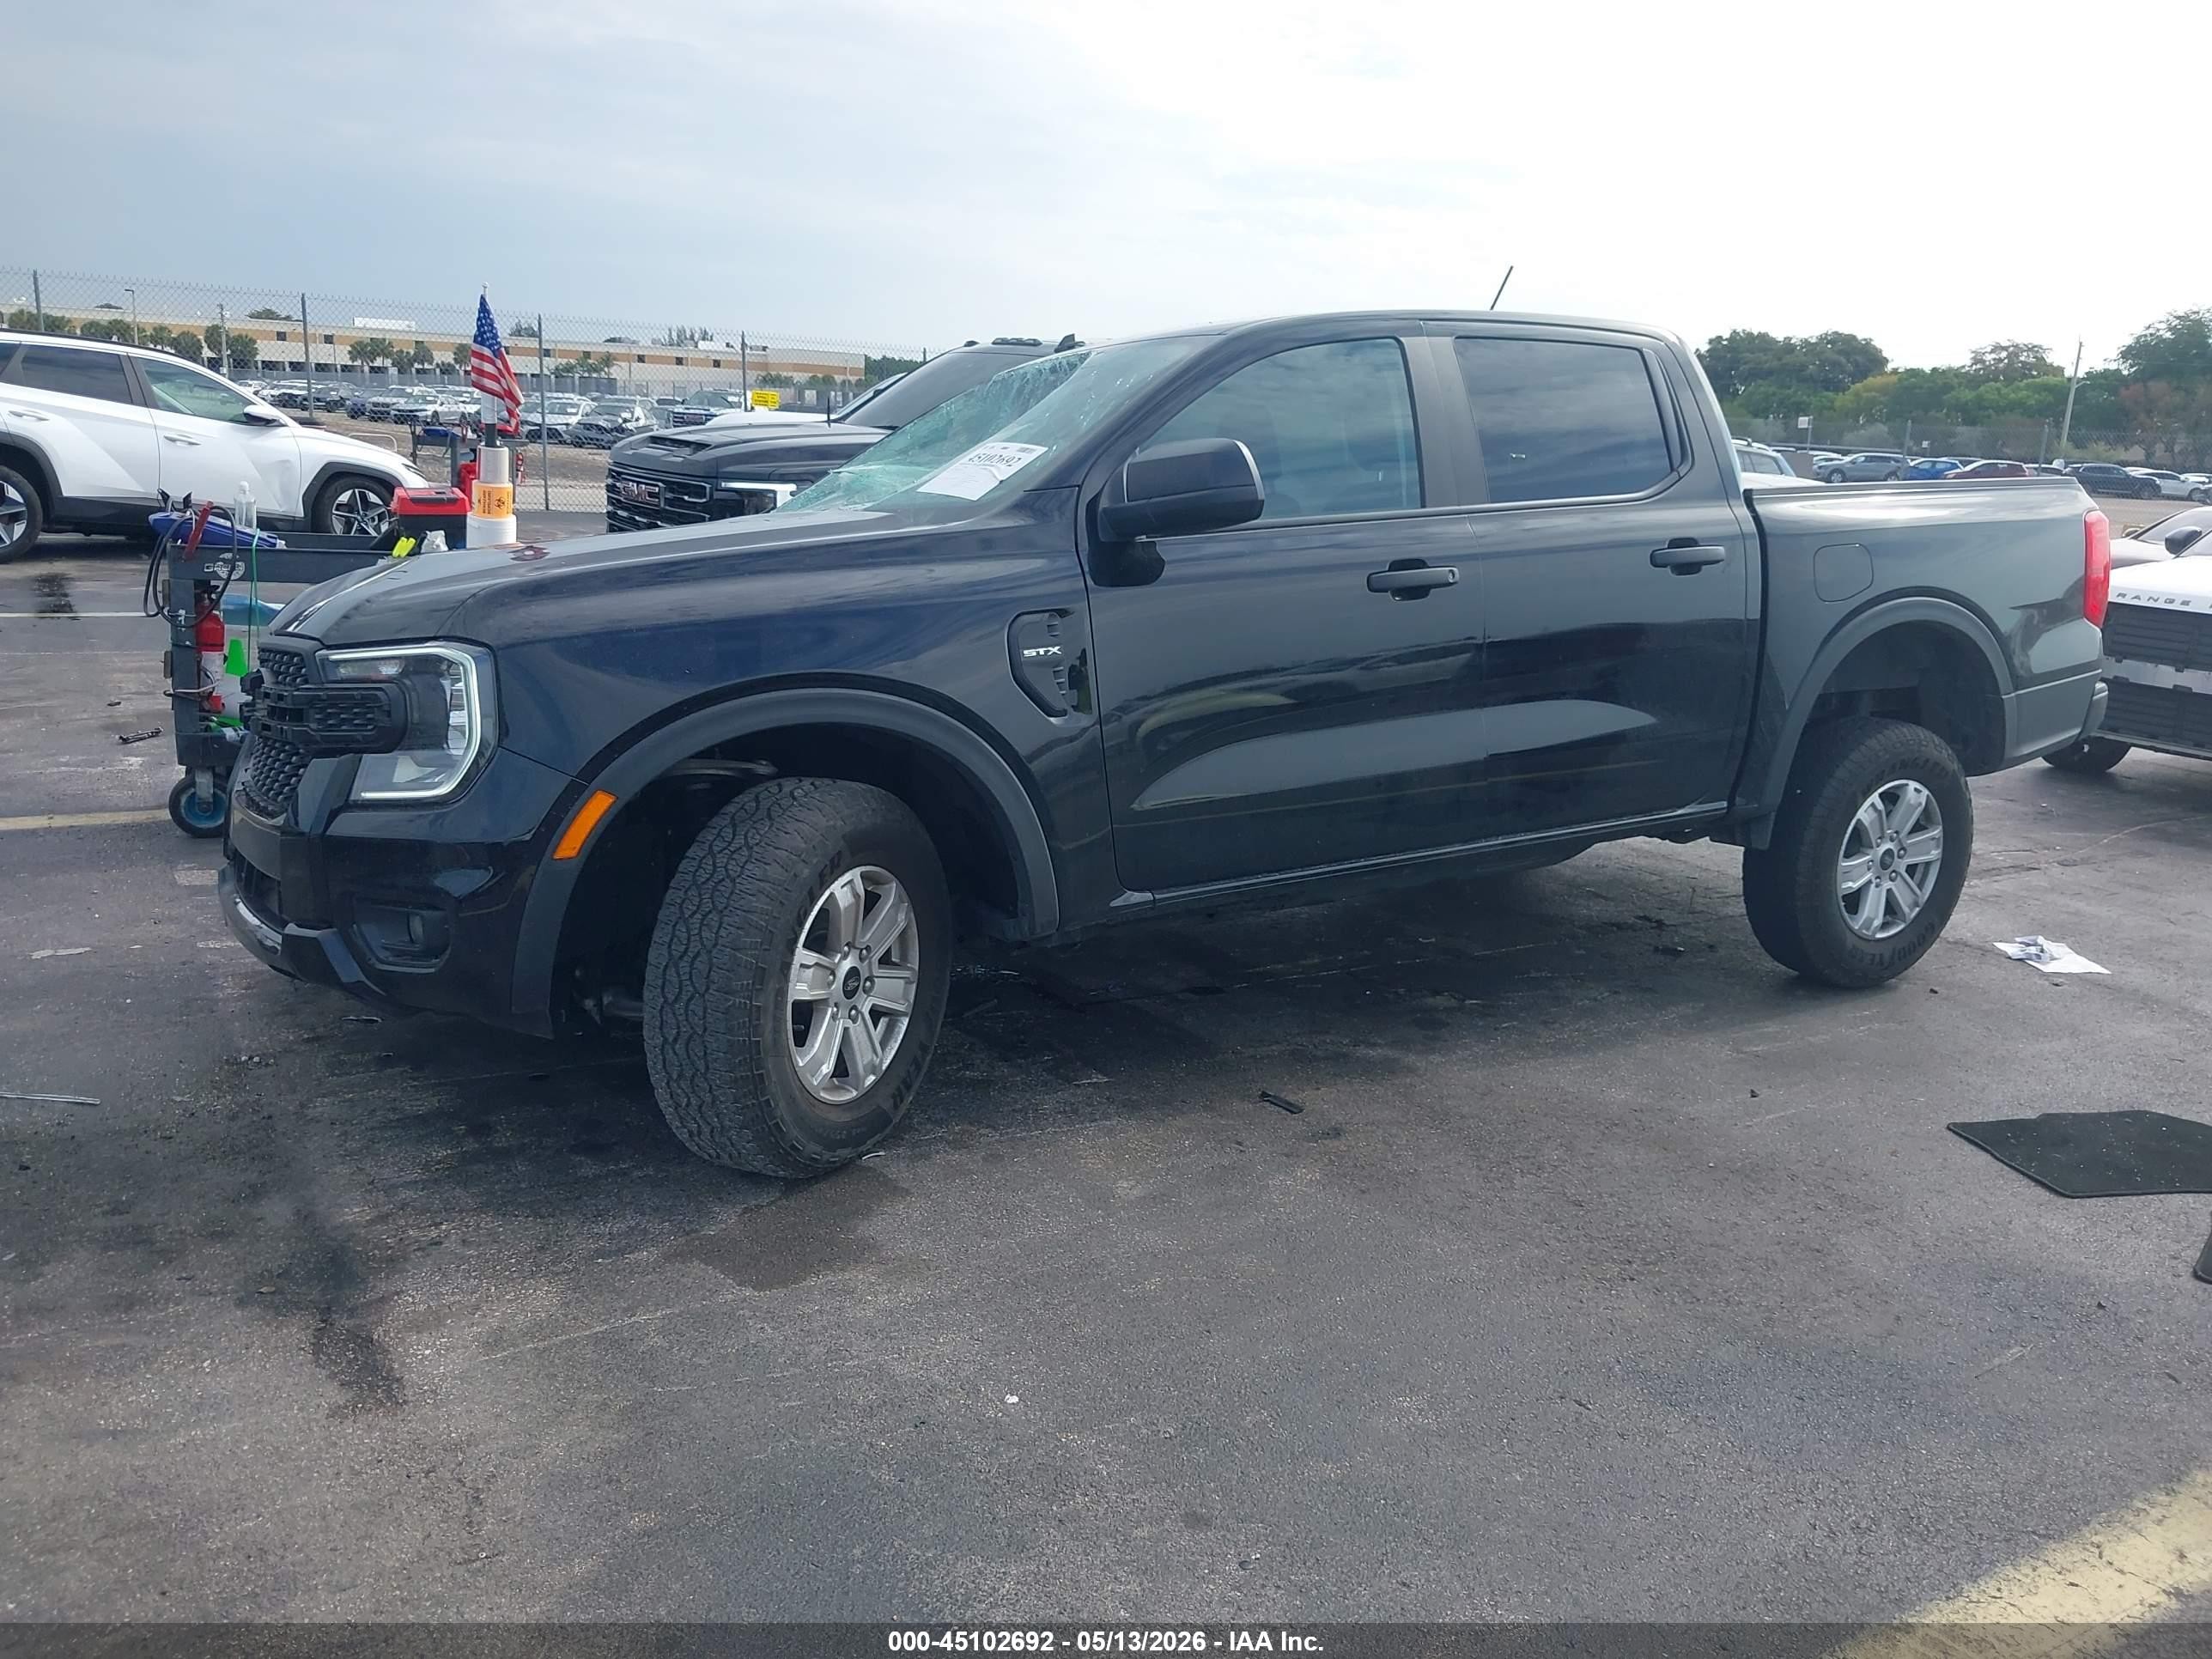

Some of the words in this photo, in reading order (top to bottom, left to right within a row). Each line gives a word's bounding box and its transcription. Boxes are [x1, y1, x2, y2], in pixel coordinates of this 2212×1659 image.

[969, 453, 1022, 467] 45102692
[619, 481, 659, 504] GMC
[2116, 592, 2191, 606] RANGE
[1023, 646, 1062, 658] STX
